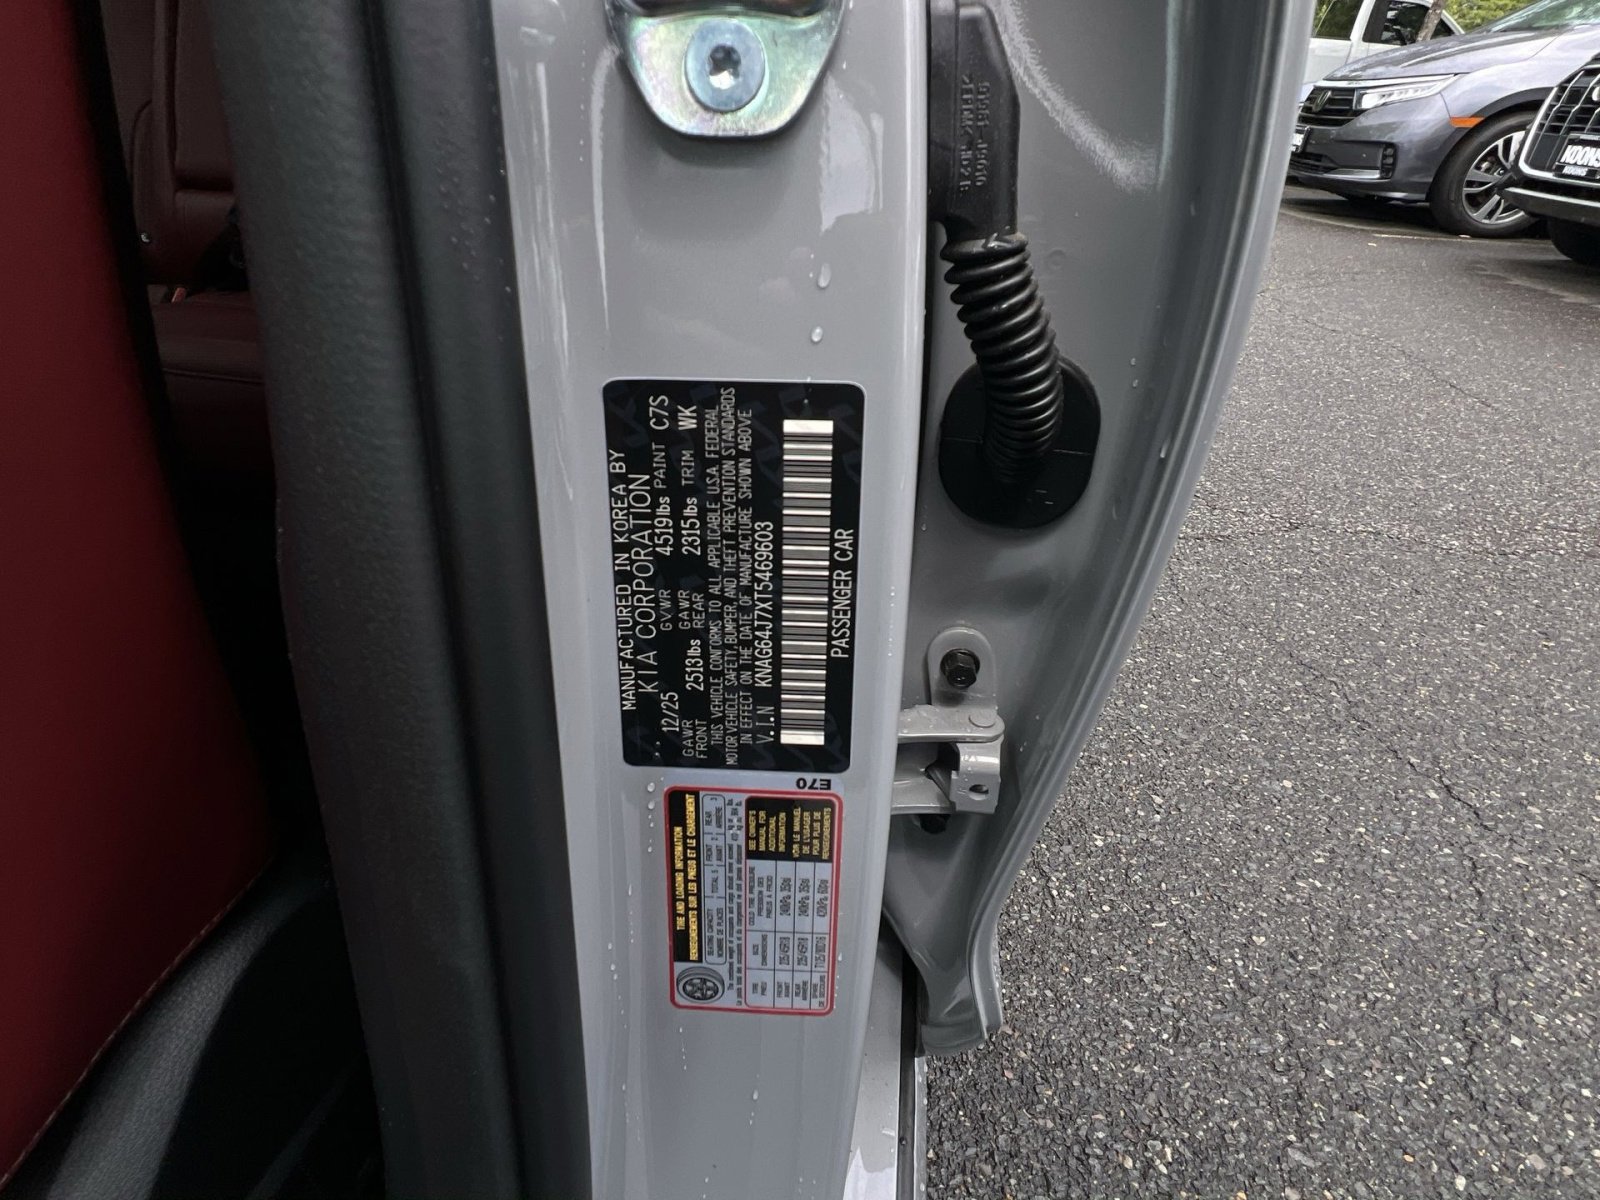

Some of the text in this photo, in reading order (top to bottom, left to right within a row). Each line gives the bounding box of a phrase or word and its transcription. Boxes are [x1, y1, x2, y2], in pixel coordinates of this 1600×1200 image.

[649, 395, 669, 488] PAINT C7S
[705, 406, 719, 458] FEDERAL
[721, 388, 735, 456] STANDARDS
[677, 406, 698, 486] TRIM WK
[722, 460, 736, 532] PREVENTION
[707, 502, 720, 568] APPLICABLE
[723, 540, 736, 572] THEFT
[738, 408, 752, 744] IN EFFECT ON THE DATE OF MANUFACTURE SHOWN ABOVE
[609, 450, 636, 710] MANUFACTURED IN KOREA BY
[628, 474, 658, 692] KIA CORPORATION
[708, 575, 722, 594] ALL
[724, 578, 737, 598] AND
[831, 529, 854, 658] PASSENGER CAR
[659, 589, 672, 630] GVWR
[678, 590, 690, 629] GAWR
[692, 593, 705, 628] REAR
[709, 600, 722, 612] TO
[754, 521, 773, 687] KNAG64J7XT5469603
[710, 620, 722, 670] CONFORMS
[661, 692, 679, 732] 12/25
[710, 677, 723, 718] VEHICLE
[725, 692, 738, 732] VEHICLE
[682, 720, 694, 756] GAWR
[696, 719, 708, 758] FRONT
[711, 724, 723, 745] THIS
[726, 736, 738, 764] MOTOR
[796, 777, 832, 790] E70
[686, 794, 695, 836] CHARGEMENT
[687, 839, 696, 847] LE
[802, 845, 810, 854] DE
[812, 839, 820, 855] POUR
[674, 826, 685, 930] TIRE AND LOADING INFORMATION
[688, 860, 696, 880] PNEUS
[688, 882, 696, 893] LES
[688, 896, 697, 908] SUR
